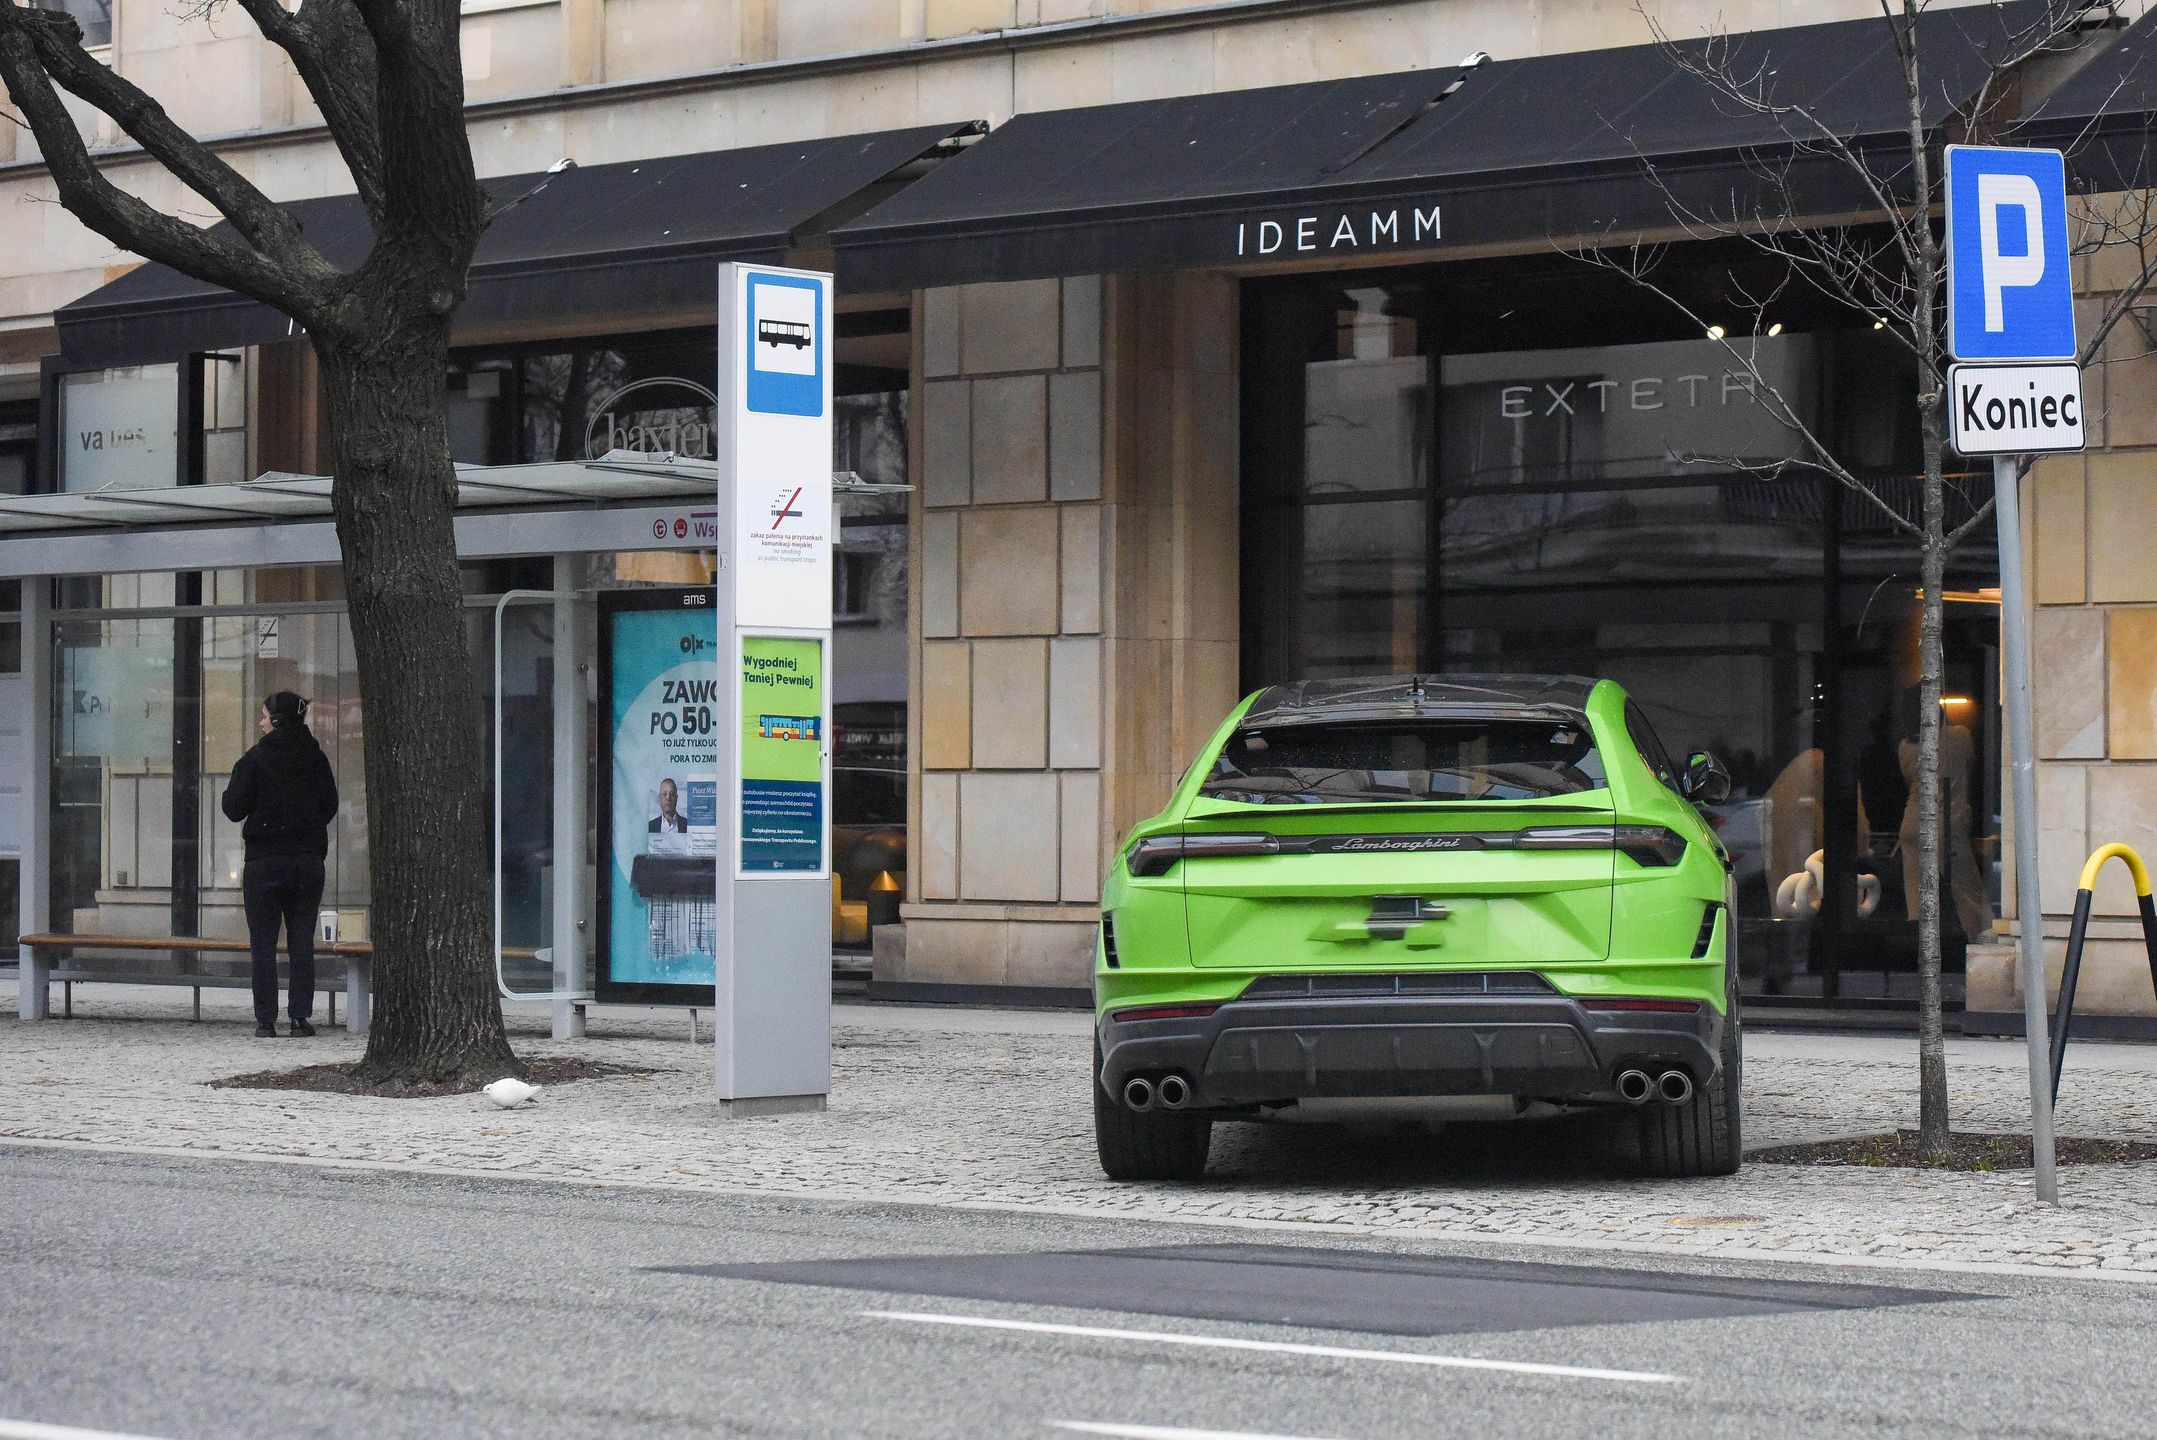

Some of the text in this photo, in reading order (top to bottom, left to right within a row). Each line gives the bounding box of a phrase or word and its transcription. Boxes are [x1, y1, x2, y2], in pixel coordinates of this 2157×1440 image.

[1237, 205, 1441, 256] IDEAMM
[1977, 173, 2046, 333] P
[1501, 371, 1755, 418] EXTETA
[1962, 381, 2079, 432] Koniec
[694, 521, 718, 541] Ws
[683, 594, 706, 605] ams
[743, 655, 797, 672] Wygodniej
[743, 672, 813, 689] Taniej Pewniej
[650, 711, 678, 735] PO
[662, 739, 672, 747] TO
[673, 737, 686, 747] JUŻ
[687, 739, 707, 747] TYLKO
[670, 755, 691, 763] PORA
[691, 755, 701, 763] TO
[1331, 838, 1461, 851] Lamborghini
